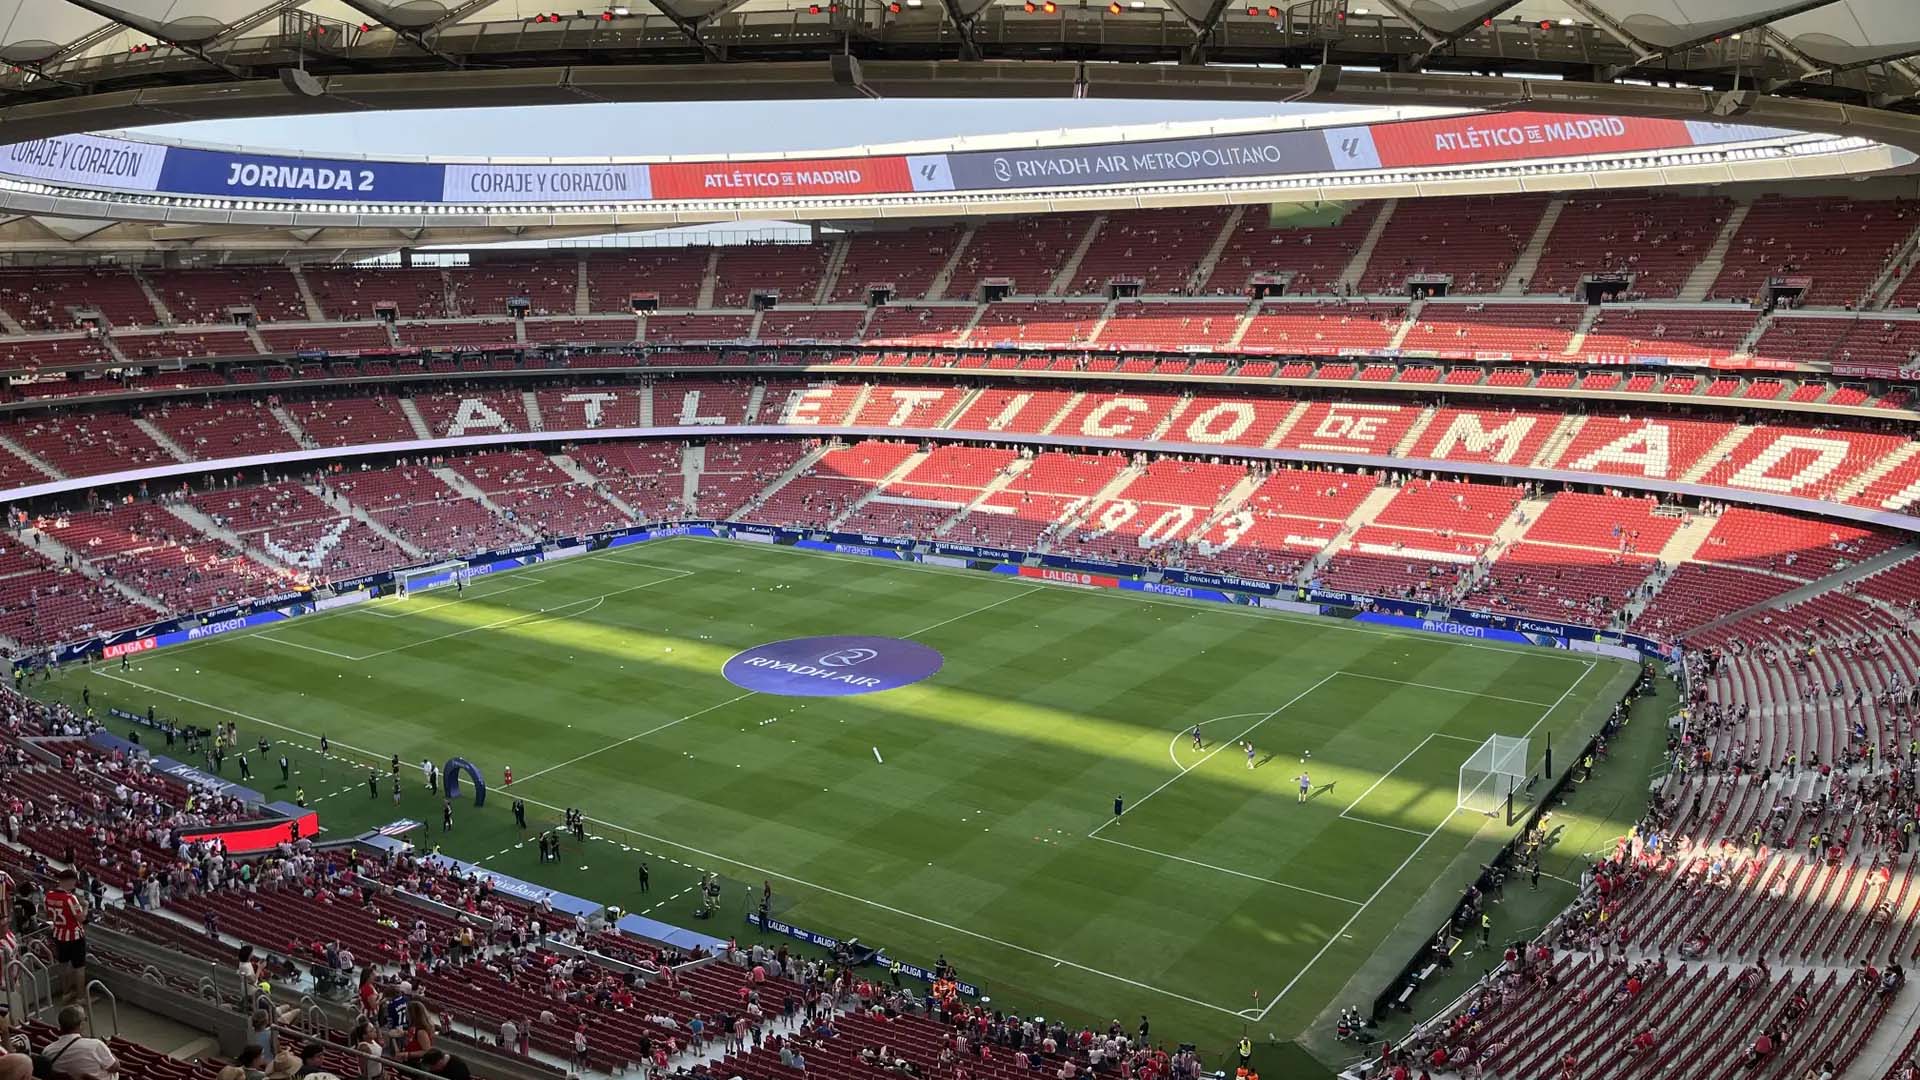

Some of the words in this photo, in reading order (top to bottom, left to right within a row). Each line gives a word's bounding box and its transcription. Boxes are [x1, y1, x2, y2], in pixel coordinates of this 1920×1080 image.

[1435, 126, 1524, 151] ATLÉTICO
[1528, 129, 1541, 140] DE
[1545, 118, 1625, 142] MADRID
[11, 140, 61, 167] CORAJE
[60, 142, 73, 169] Y
[70, 145, 143, 177] CORAZÓN
[1016, 158, 1090, 177] RIYADH
[1095, 155, 1129, 173] AIR
[1132, 145, 1281, 171] METROPOLITANO
[227, 162, 353, 191] JORNADA
[358, 170, 374, 191] 2
[471, 173, 533, 193] CORAJE
[537, 173, 546, 193] Y
[550, 168, 627, 192] CORAZÓN
[704, 170, 779, 188] ATLÉTICO
[783, 174, 793, 184] DE
[797, 171, 861, 186] MADRID
[1313, 414, 1389, 441] DE
[658, 527, 690, 537] kraken
[844, 545, 872, 557] kraken
[459, 564, 492, 579] kraken
[1042, 569, 1079, 583] LALIGA
[1153, 583, 1193, 598] kraken
[1189, 576, 1210, 585] RIYADH
[1223, 576, 1239, 586] VISIT
[1241, 579, 1271, 590] RWANDA
[1318, 589, 1347, 601] kraken
[200, 617, 247, 637] kraken
[1436, 622, 1484, 638] kraken
[1530, 624, 1559, 635] CaixaBank
[105, 640, 142, 658] LALIGA
[744, 656, 837, 679] RIYADH
[833, 674, 881, 687] AIR
[768, 920, 789, 934] LALIGA
[813, 935, 835, 949] LALIGA
[954, 981, 975, 996] ALIGA
